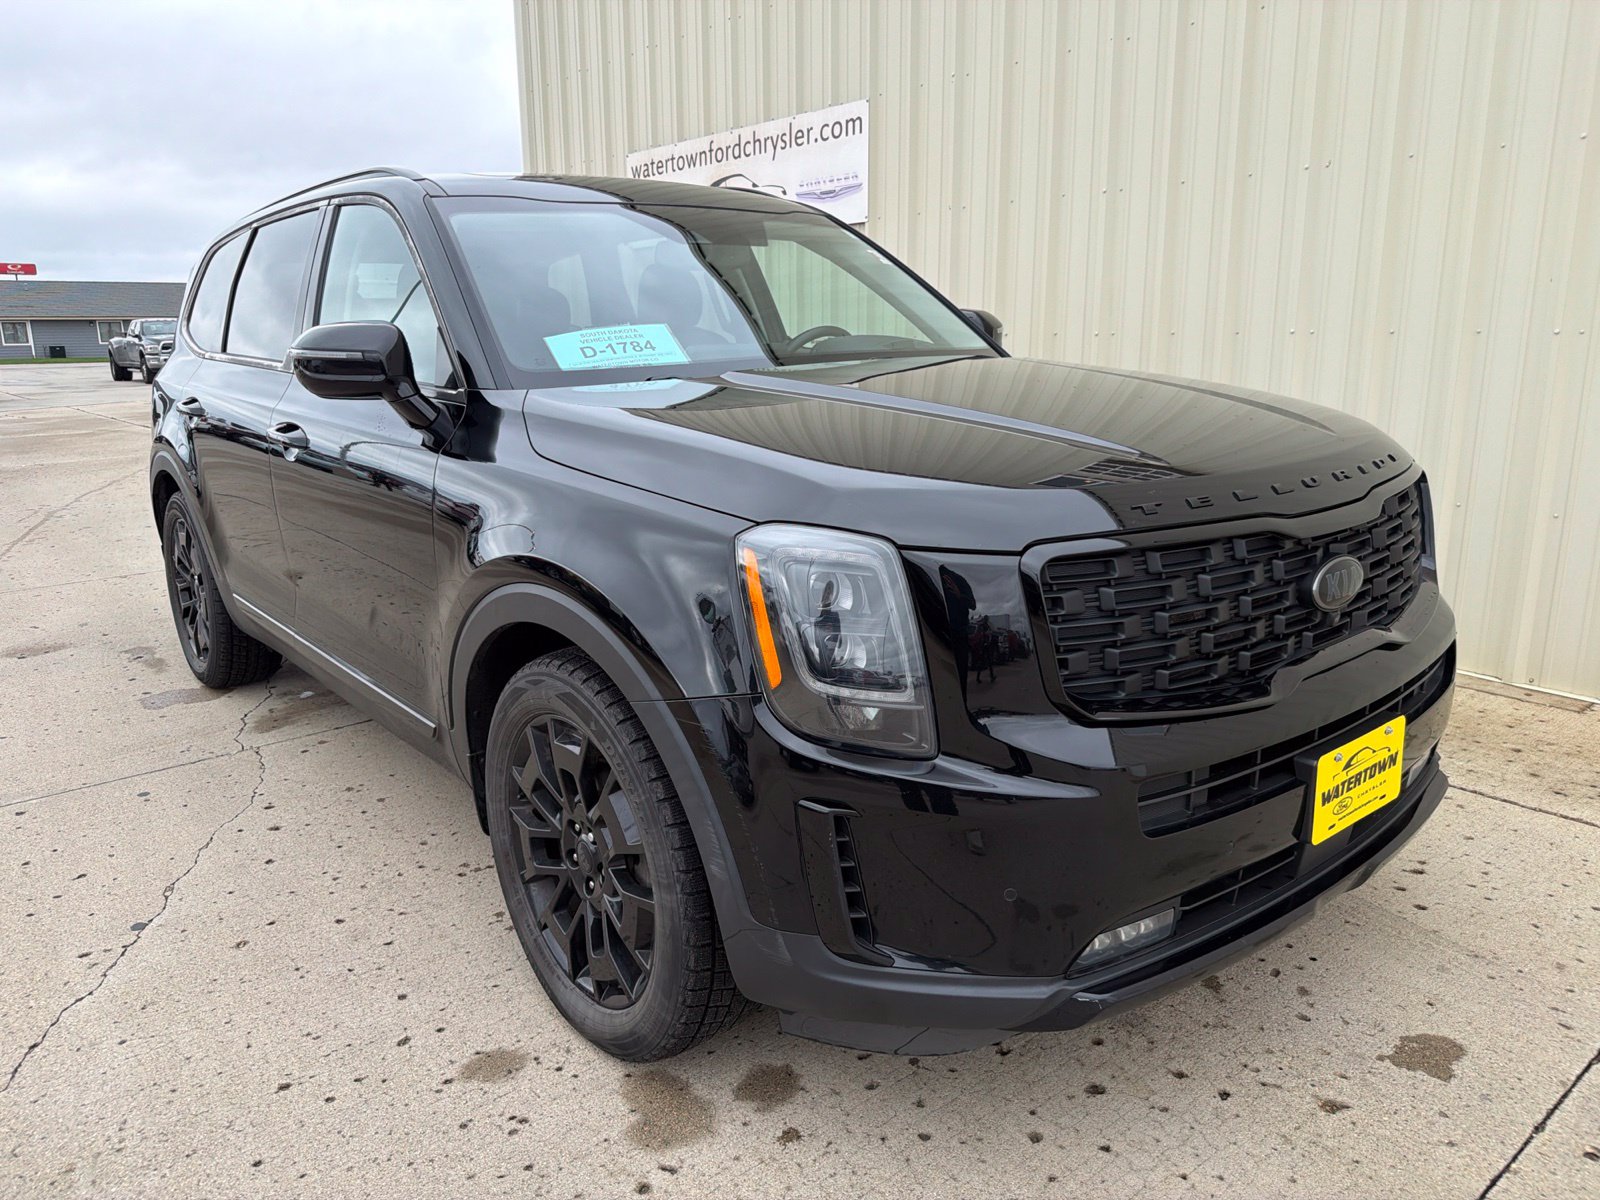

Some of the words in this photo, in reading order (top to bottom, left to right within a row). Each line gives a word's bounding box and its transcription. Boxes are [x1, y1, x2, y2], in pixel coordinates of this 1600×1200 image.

[631, 116, 863, 179] watertownfordchrysler.com
[580, 329, 606, 338] SOUTH
[580, 336, 613, 344] VEHICLE
[614, 333, 645, 341] DEALER
[579, 340, 656, 359] D-1784
[1321, 749, 1399, 807] WATERTOWN
[1357, 779, 1387, 798] CHRYSLER
